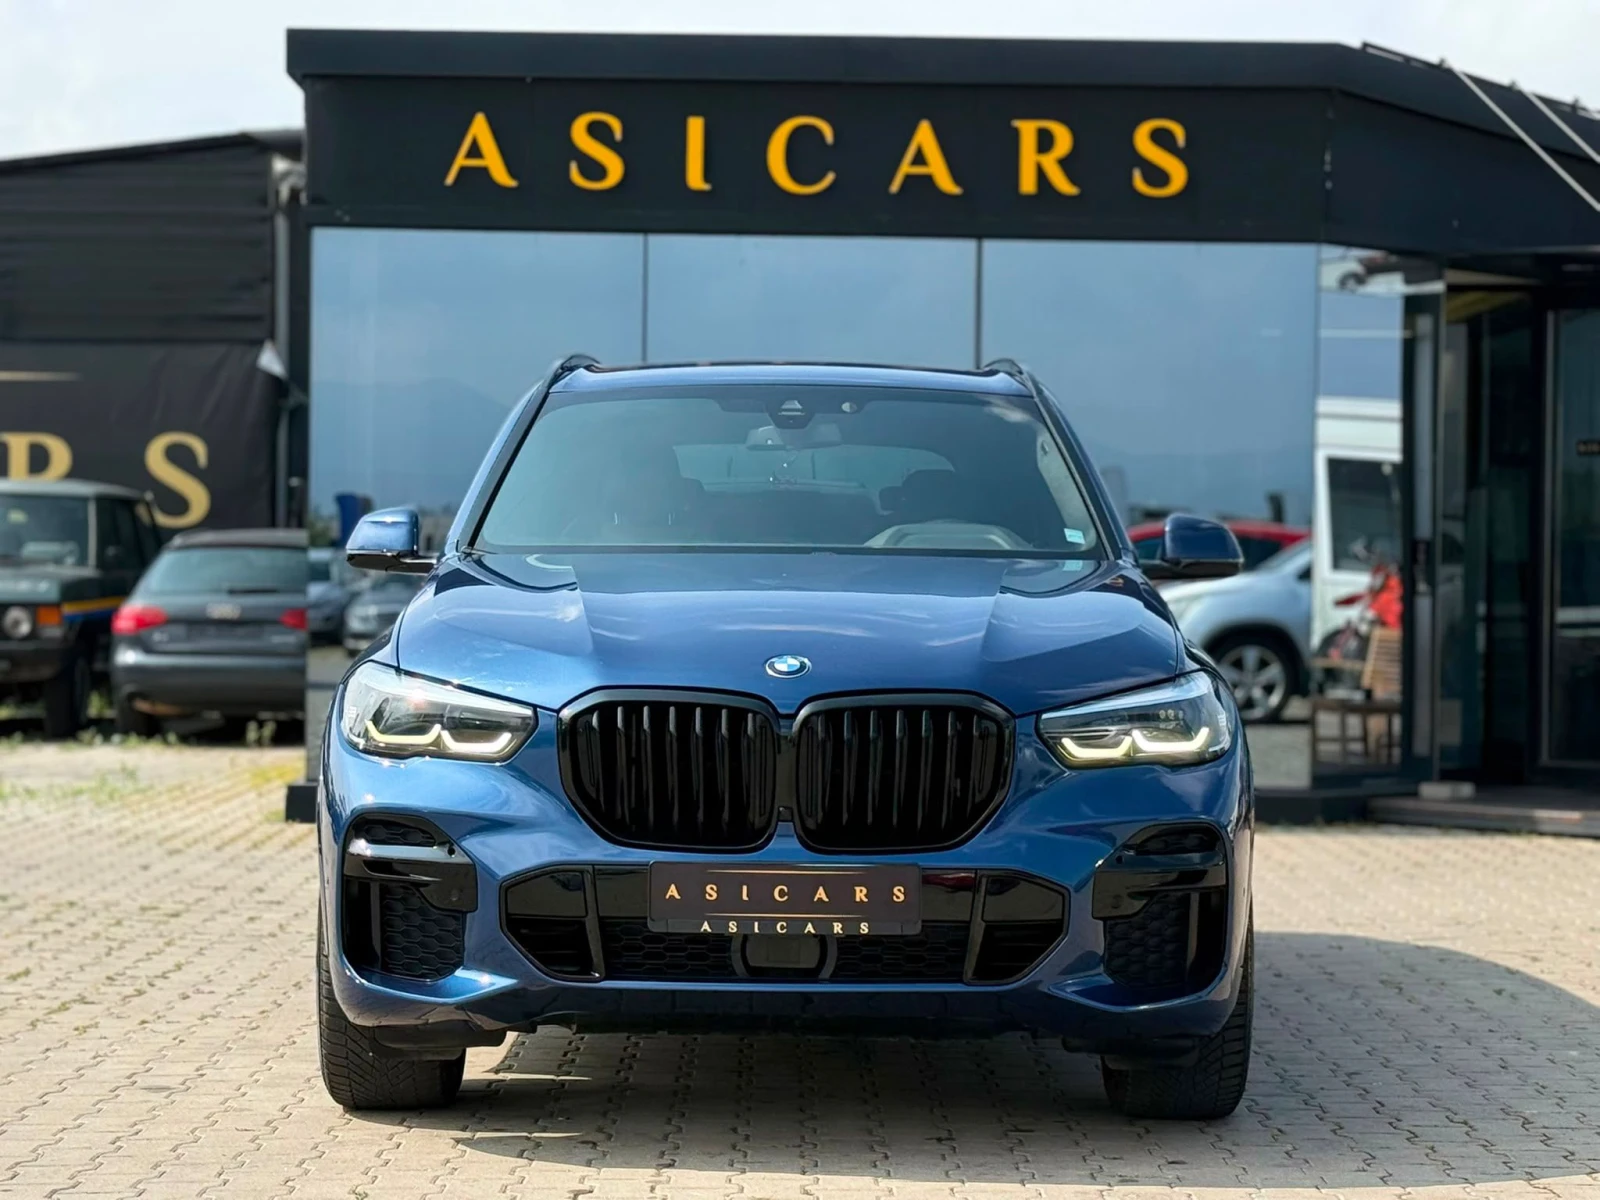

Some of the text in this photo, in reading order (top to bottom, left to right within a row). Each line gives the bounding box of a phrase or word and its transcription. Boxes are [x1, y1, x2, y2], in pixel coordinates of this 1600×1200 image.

[444, 111, 1189, 198] ASICARS
[665, 883, 906, 902] ASICARS
[700, 920, 869, 934] ASICARS
